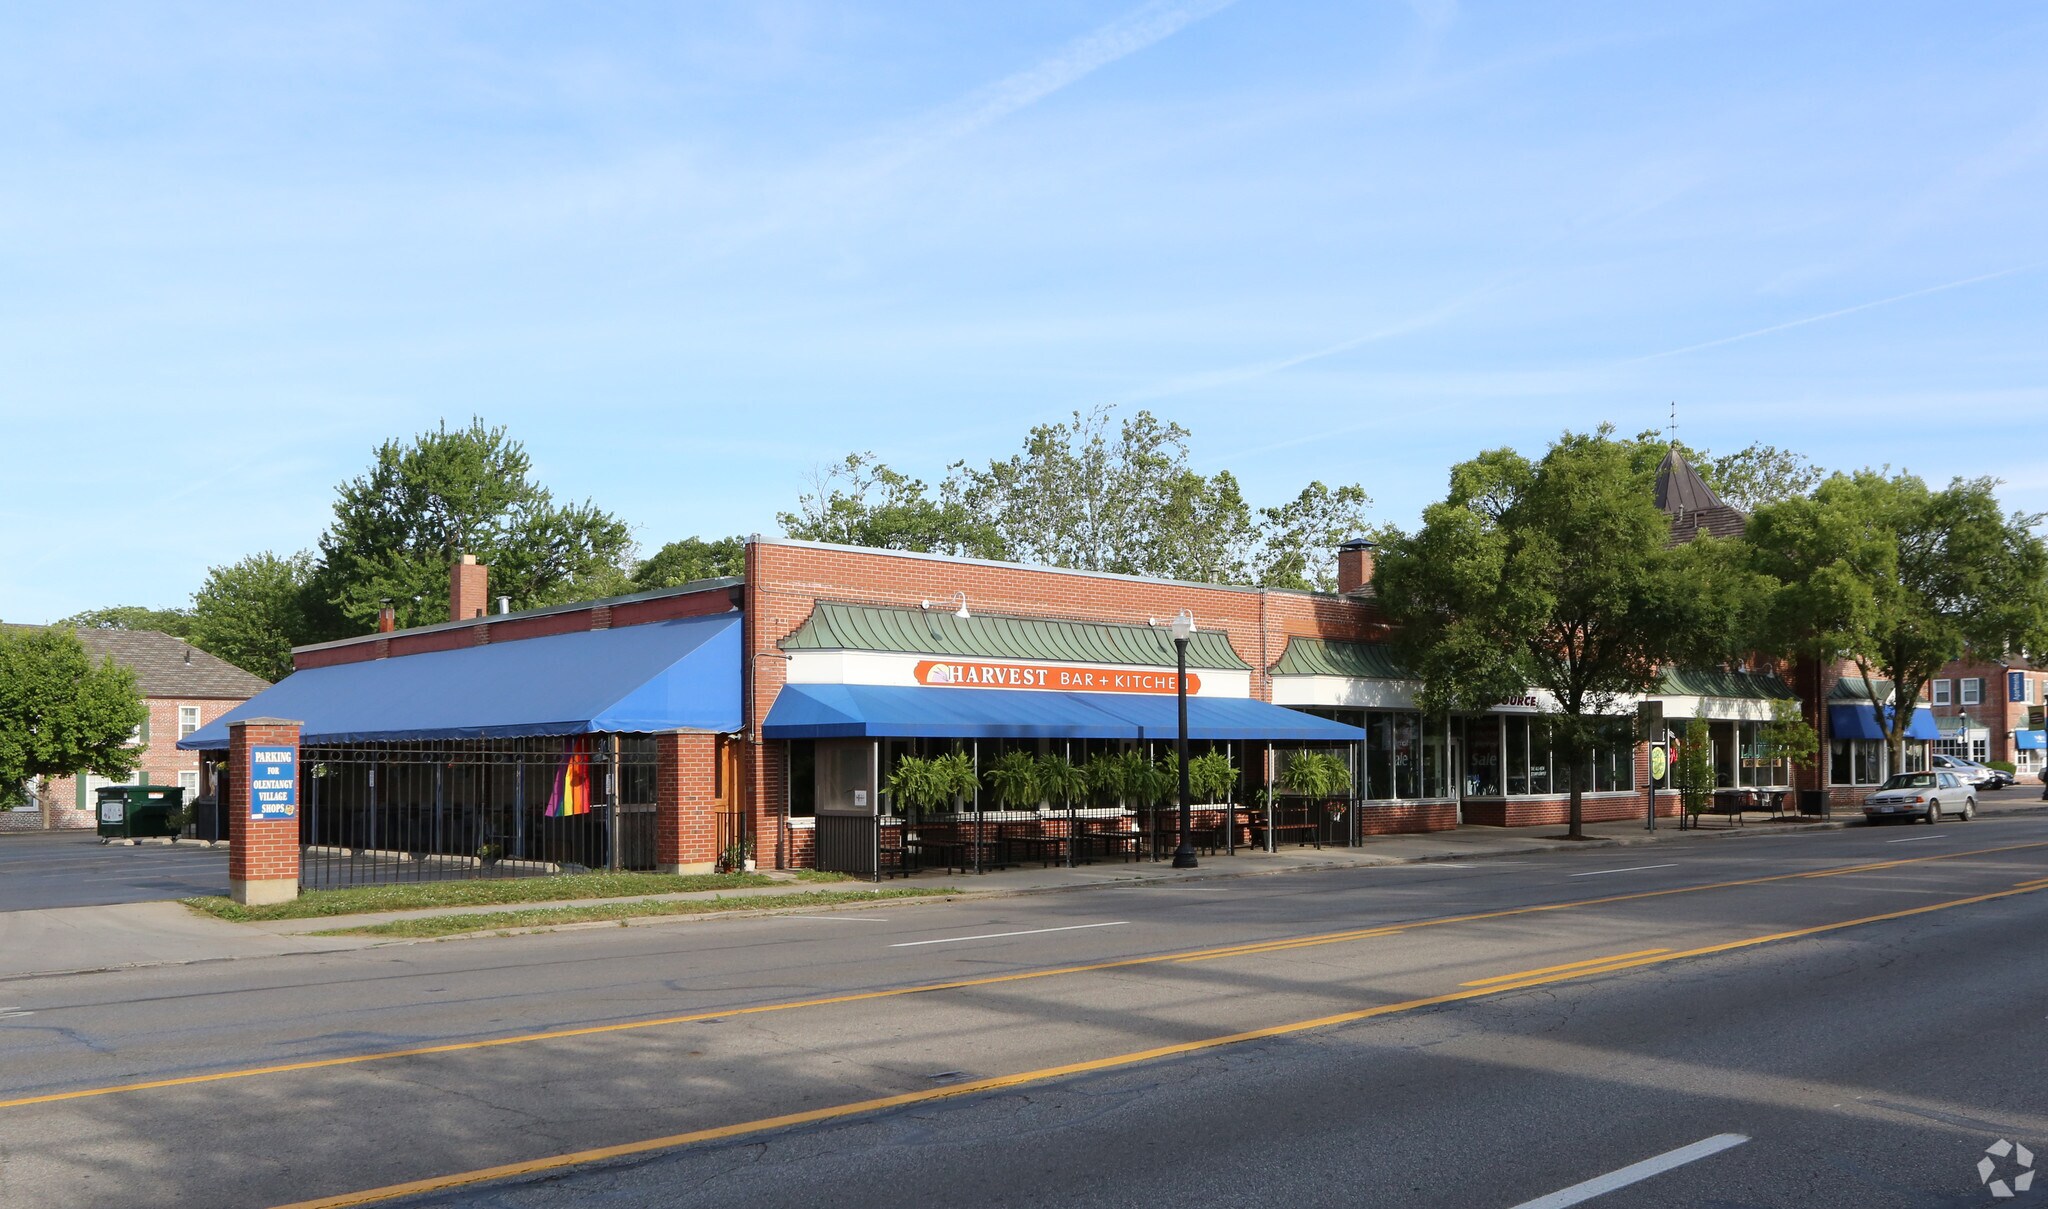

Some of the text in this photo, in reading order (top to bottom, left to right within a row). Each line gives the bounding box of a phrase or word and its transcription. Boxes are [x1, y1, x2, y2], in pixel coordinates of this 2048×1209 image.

[947, 664, 1048, 686] HARVEST
[1060, 672, 1093, 686] BAR
[255, 752, 291, 762] PARKING
[1471, 752, 1497, 766] Sale
[253, 780, 293, 789] OLENTANGY
[259, 792, 287, 801] VILLAGE
[262, 804, 284, 813] SHOPS
